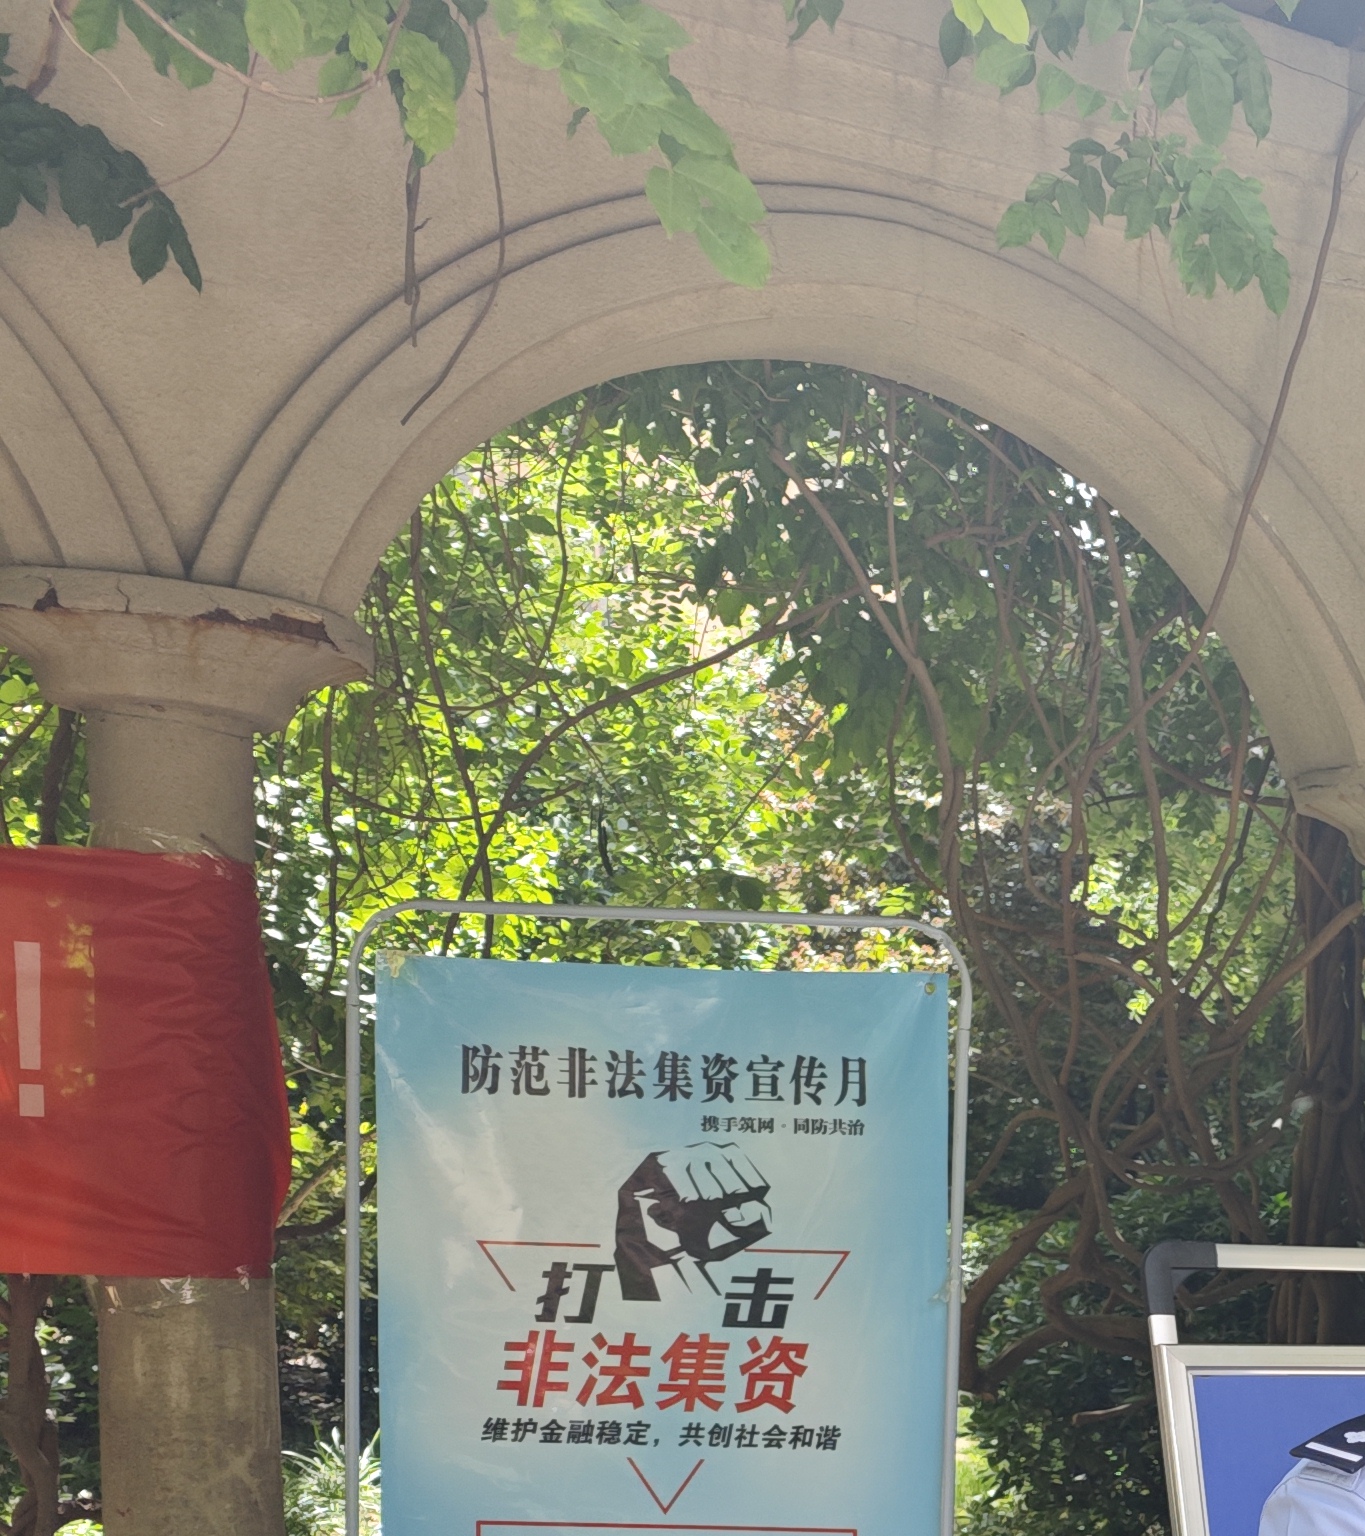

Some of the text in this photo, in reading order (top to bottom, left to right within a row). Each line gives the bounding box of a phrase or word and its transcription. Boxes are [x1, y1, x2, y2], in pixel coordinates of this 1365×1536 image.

[460, 1044, 868, 1108] 防范非法集资宣传月
[534, 1262, 795, 1329] 打 击
[496, 1329, 809, 1414] 非法集资
